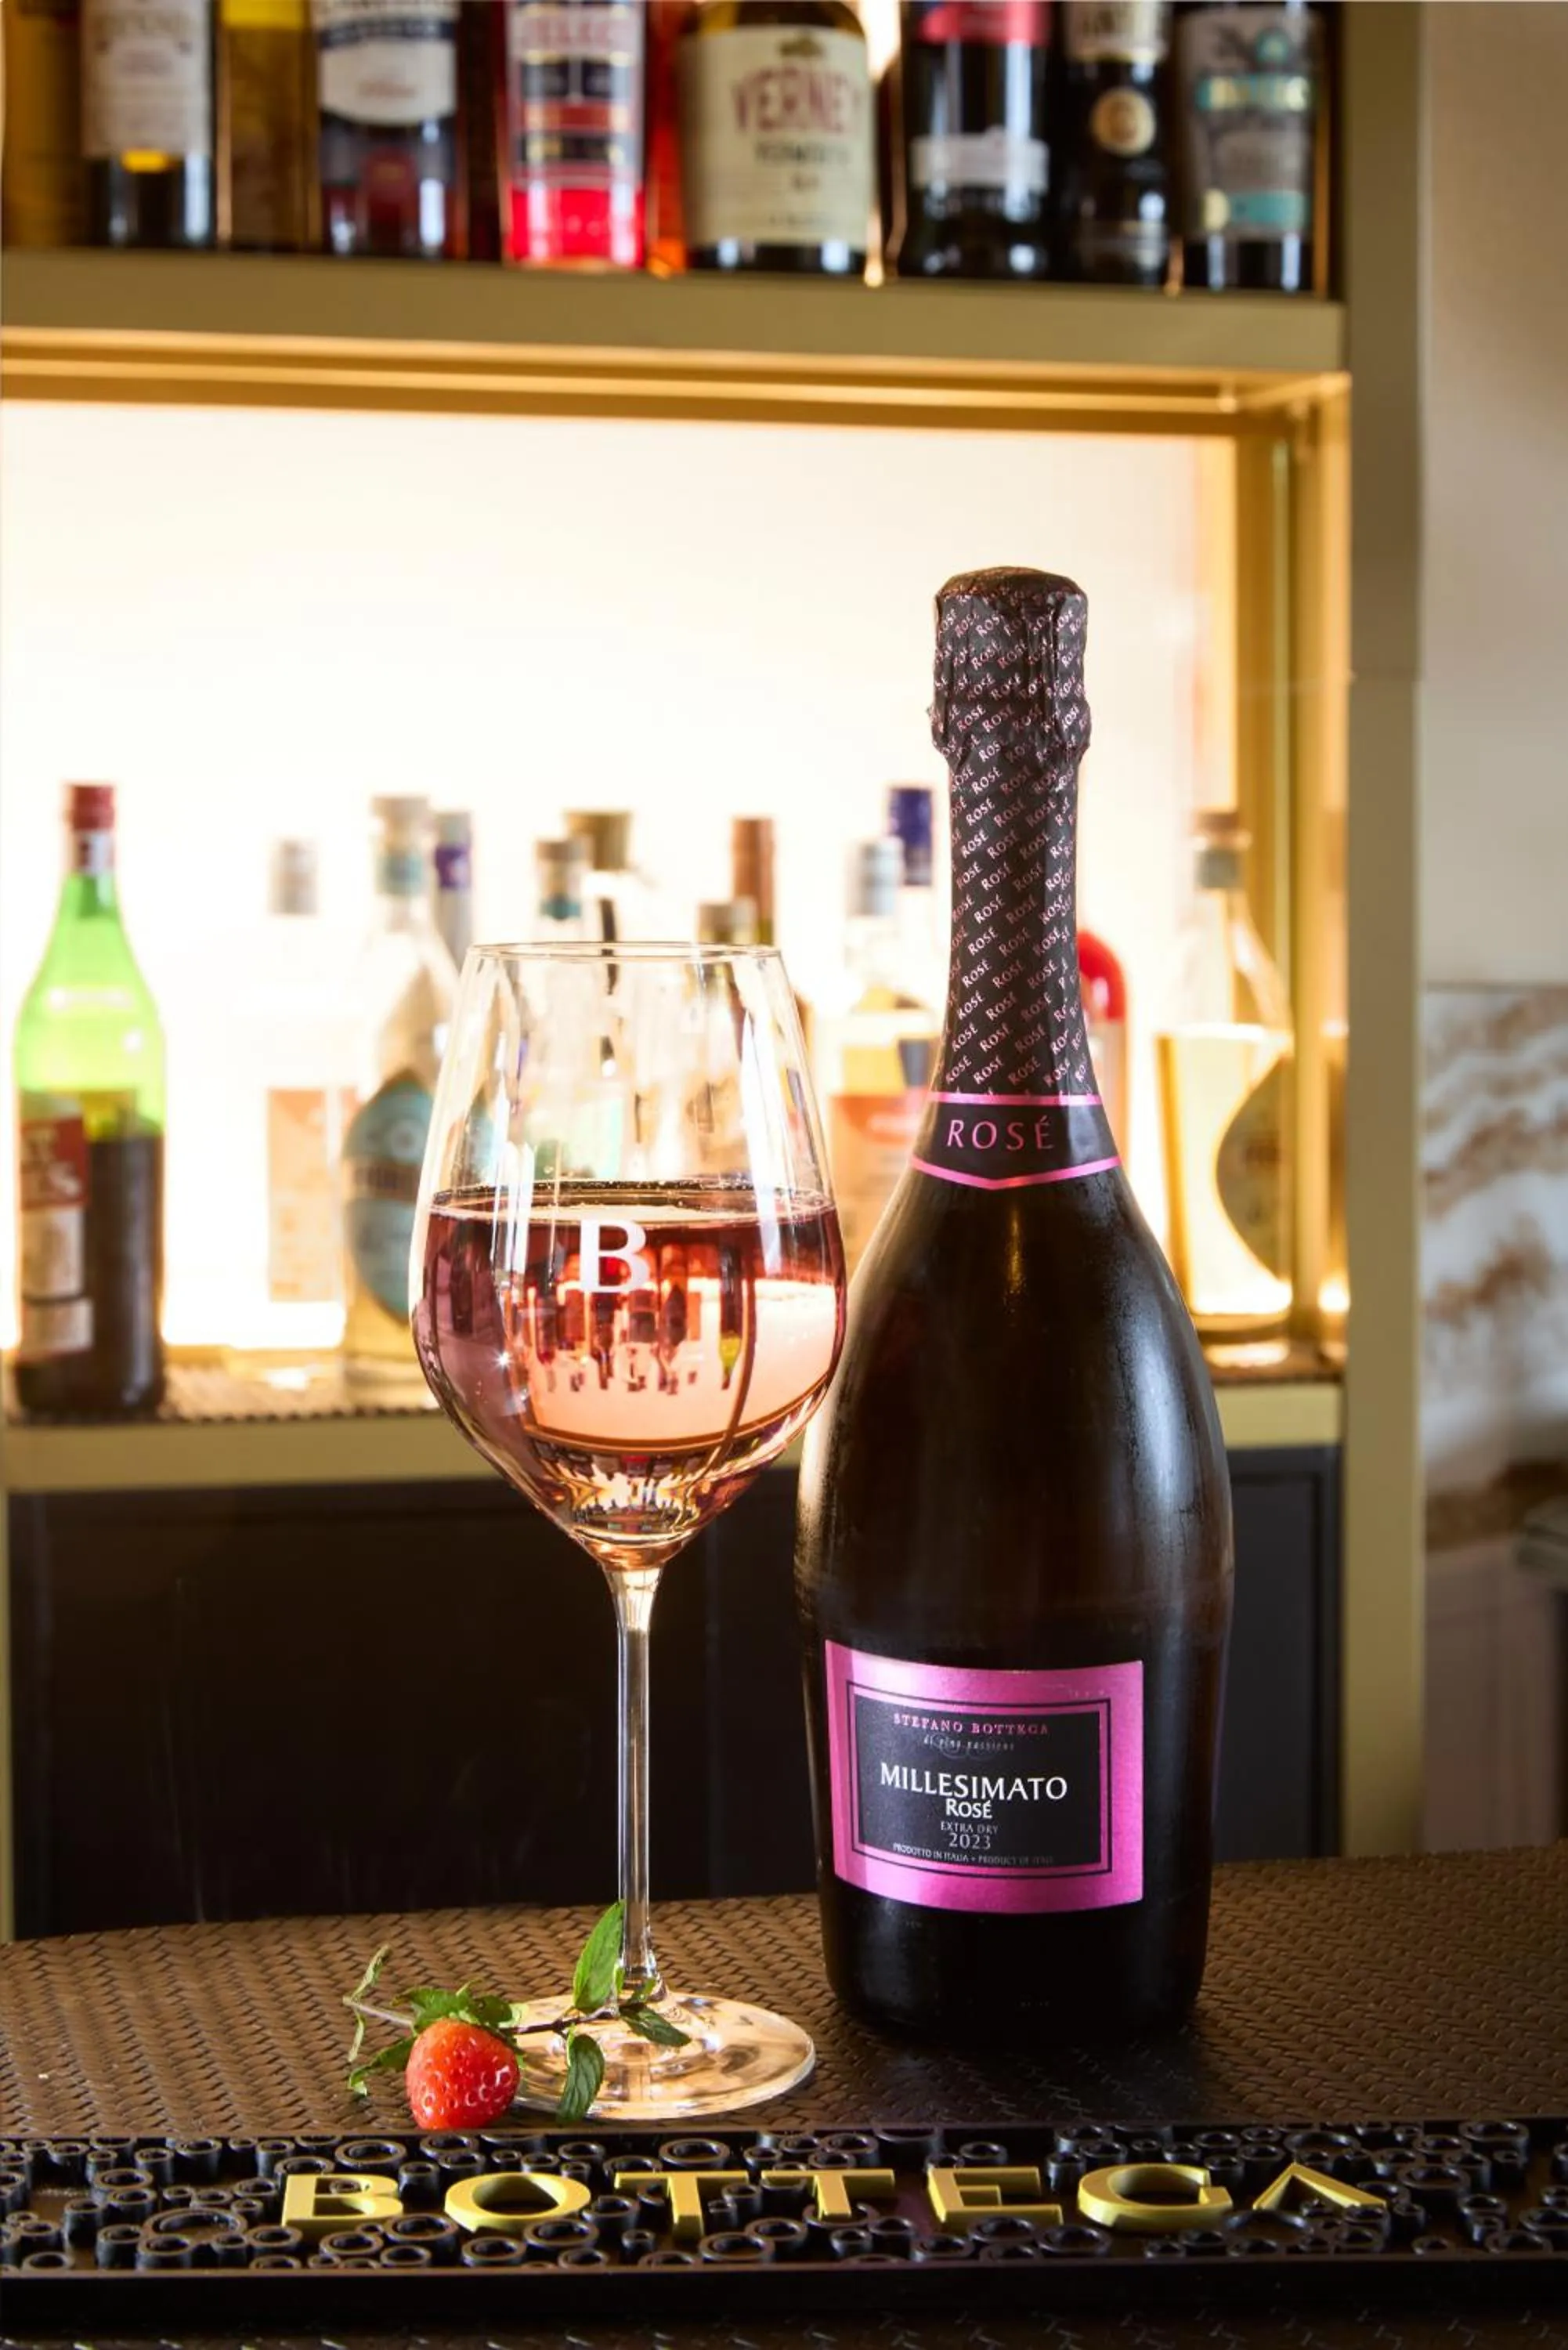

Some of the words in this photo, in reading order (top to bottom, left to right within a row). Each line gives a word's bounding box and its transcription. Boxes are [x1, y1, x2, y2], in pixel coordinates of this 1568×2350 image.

[945, 1115, 1056, 1151] ROSÉ
[579, 1218, 651, 1294] B
[893, 1712, 963, 1733] STEFANO
[970, 1722, 1049, 1735] BOTTEGA
[880, 1762, 1068, 1802] MILLESIMATO
[940, 1820, 974, 1833] EXTRA
[977, 1824, 999, 1835] DRY
[948, 1832, 992, 1850] 2023
[892, 1842, 932, 1858] PRODOTTO
[280, 2162, 1387, 2238] BOTTEGA
